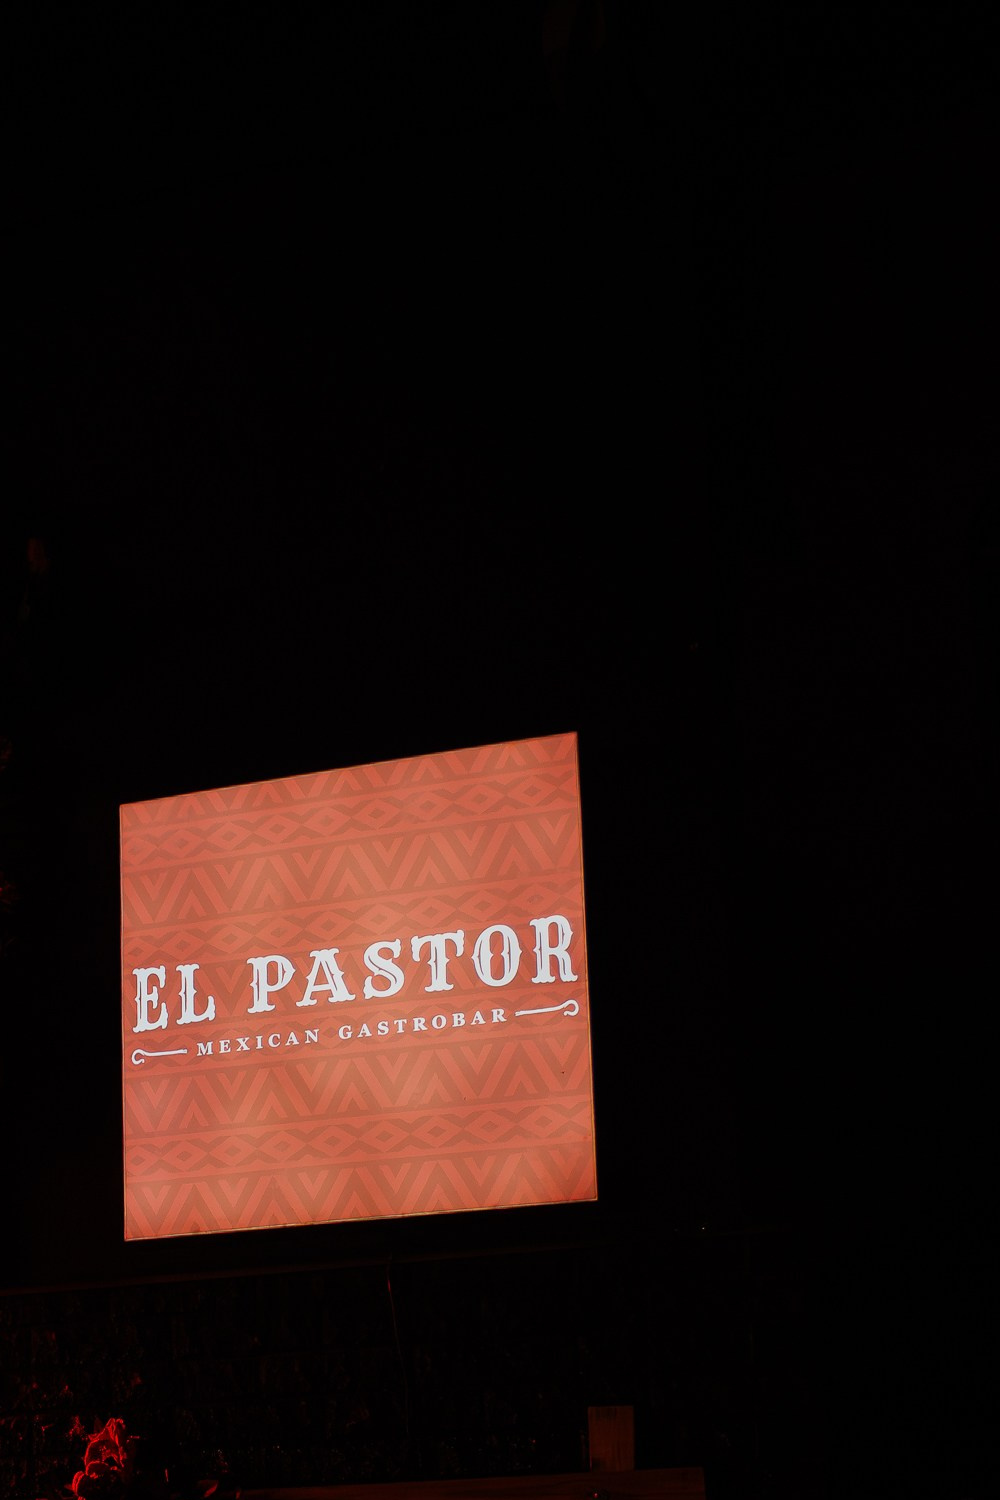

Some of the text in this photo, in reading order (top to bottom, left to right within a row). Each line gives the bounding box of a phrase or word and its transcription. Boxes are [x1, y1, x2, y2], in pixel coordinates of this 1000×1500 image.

[132, 914, 579, 1033] EL PASTOR
[196, 1008, 508, 1057] MEXICAN GASTROBAR
